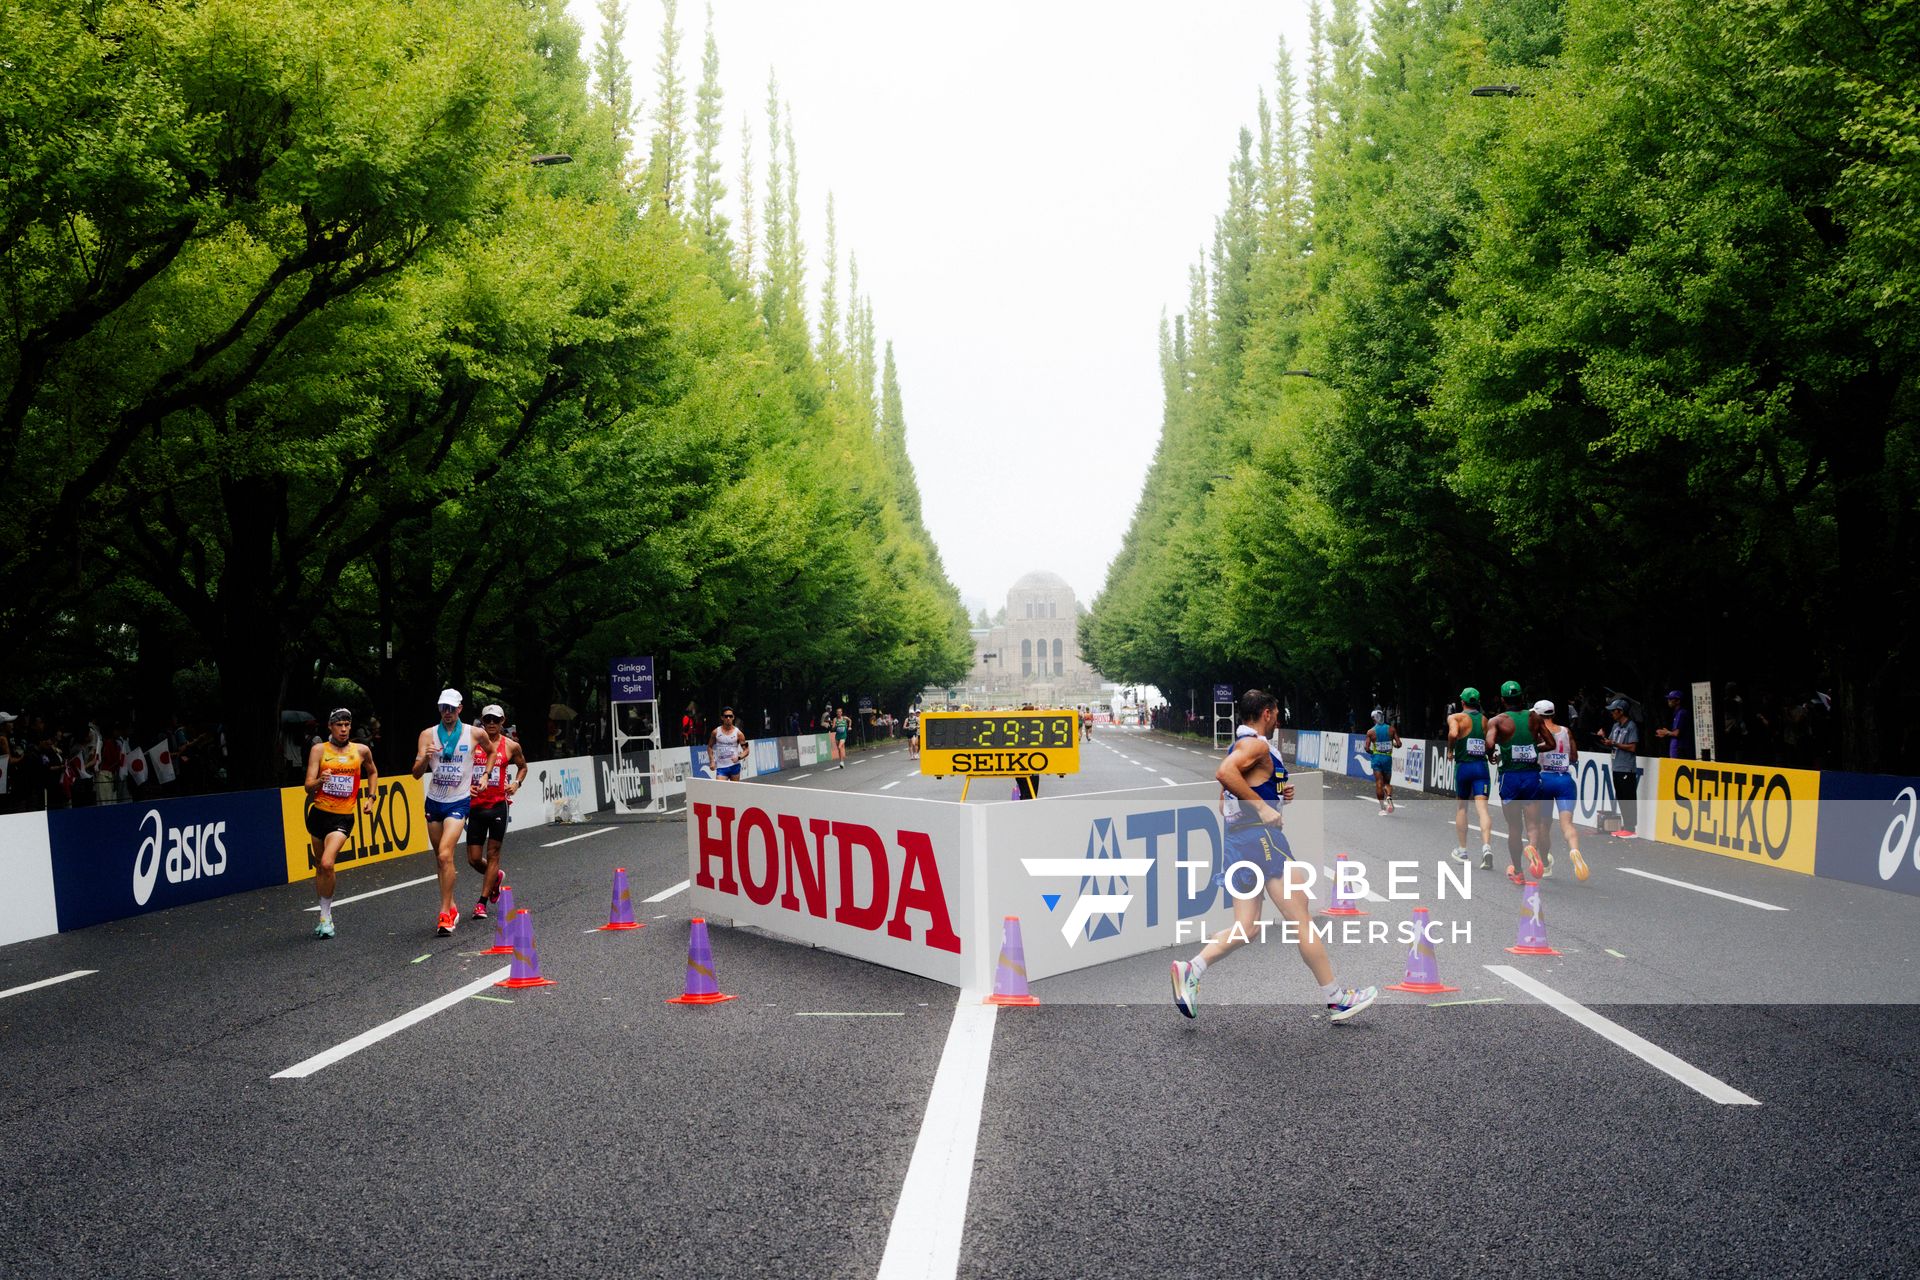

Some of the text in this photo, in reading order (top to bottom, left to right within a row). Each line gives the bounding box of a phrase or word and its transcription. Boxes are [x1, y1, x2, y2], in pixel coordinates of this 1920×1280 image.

[611, 674, 652, 683] Tree Lane
[617, 664, 646, 673] Ginkgo
[623, 685, 642, 694] Split
[440, 765, 461, 773] TDK
[952, 752, 1048, 772] SEIKO
[1431, 746, 1457, 792] Deloi
[324, 782, 347, 791] FRENZL
[1575, 759, 1644, 820] ON
[304, 781, 411, 871] IKO
[1672, 765, 1793, 860] SEIKO
[165, 820, 227, 884] asics
[693, 802, 961, 954] HONDA
